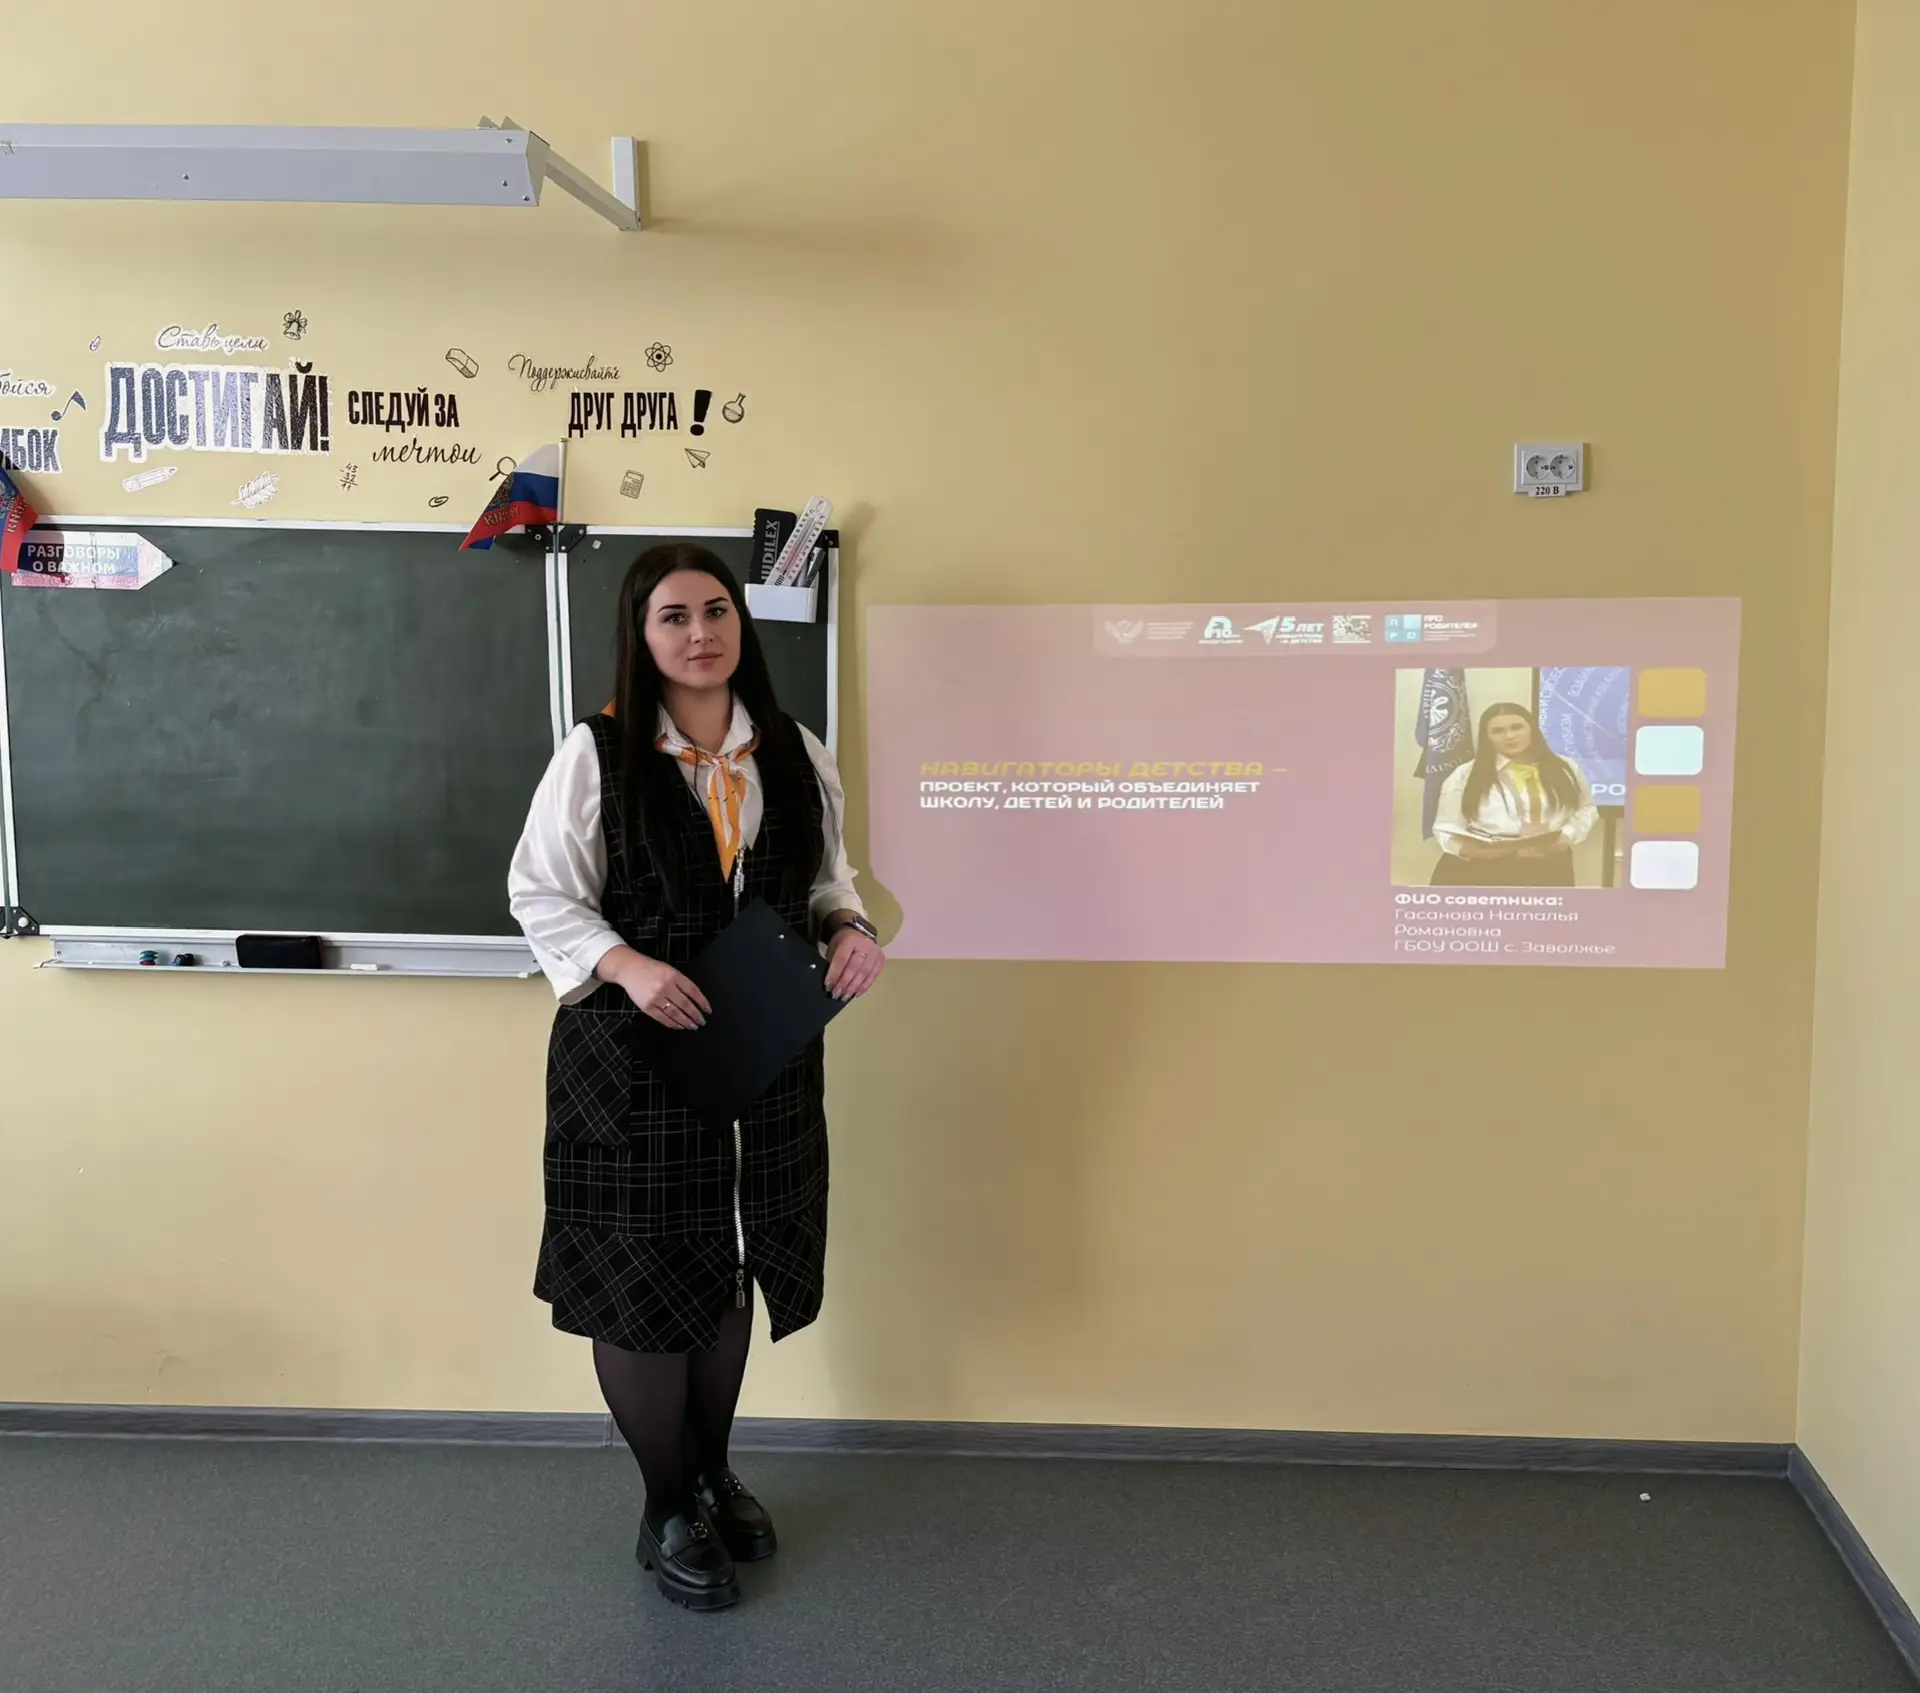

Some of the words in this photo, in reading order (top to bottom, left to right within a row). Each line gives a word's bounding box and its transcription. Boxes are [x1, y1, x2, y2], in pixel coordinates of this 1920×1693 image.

[158, 323, 219, 348] Ставь
[225, 337, 268, 352] цели
[508, 353, 620, 392] Поддерживайте
[105, 361, 330, 458] ДОСТИГАЙ!
[348, 386, 430, 433] СЛЕДУЙ
[434, 393, 460, 428] ЗА
[568, 392, 615, 438] ДРУГ
[621, 392, 678, 438] ДРУГА
[1535, 486, 1551, 495] 220
[27, 545, 120, 560] РАЗГОВОРЫ
[32, 560, 43, 572] О
[48, 560, 116, 573] ВАЖНОМ
[919, 761, 1121, 776] НАВИГАТОРЫ
[1128, 761, 1263, 777] ДЕТСТВА
[920, 781, 1007, 794] ПРОЕКТ,
[1011, 780, 1115, 793] КОТОРЫЙ
[1118, 782, 1260, 793] ОБЪЕДИНЯЕТ
[920, 796, 999, 810] ШКОЛУ,
[1003, 794, 1072, 809] ДЕТЕЙ
[1077, 796, 1092, 809] И
[1098, 795, 1224, 809] РОДИТЕЛЕЙ
[1395, 893, 1441, 904] ФИО
[1445, 895, 1564, 906] советника:
[1394, 909, 1484, 921] Гасанова
[1489, 910, 1579, 922] Наталья
[1394, 924, 1502, 937] Романовна
[1394, 940, 1445, 952] ГБОУ
[1449, 940, 1499, 953] ООШ
[1522, 942, 1616, 954] Заволжье
